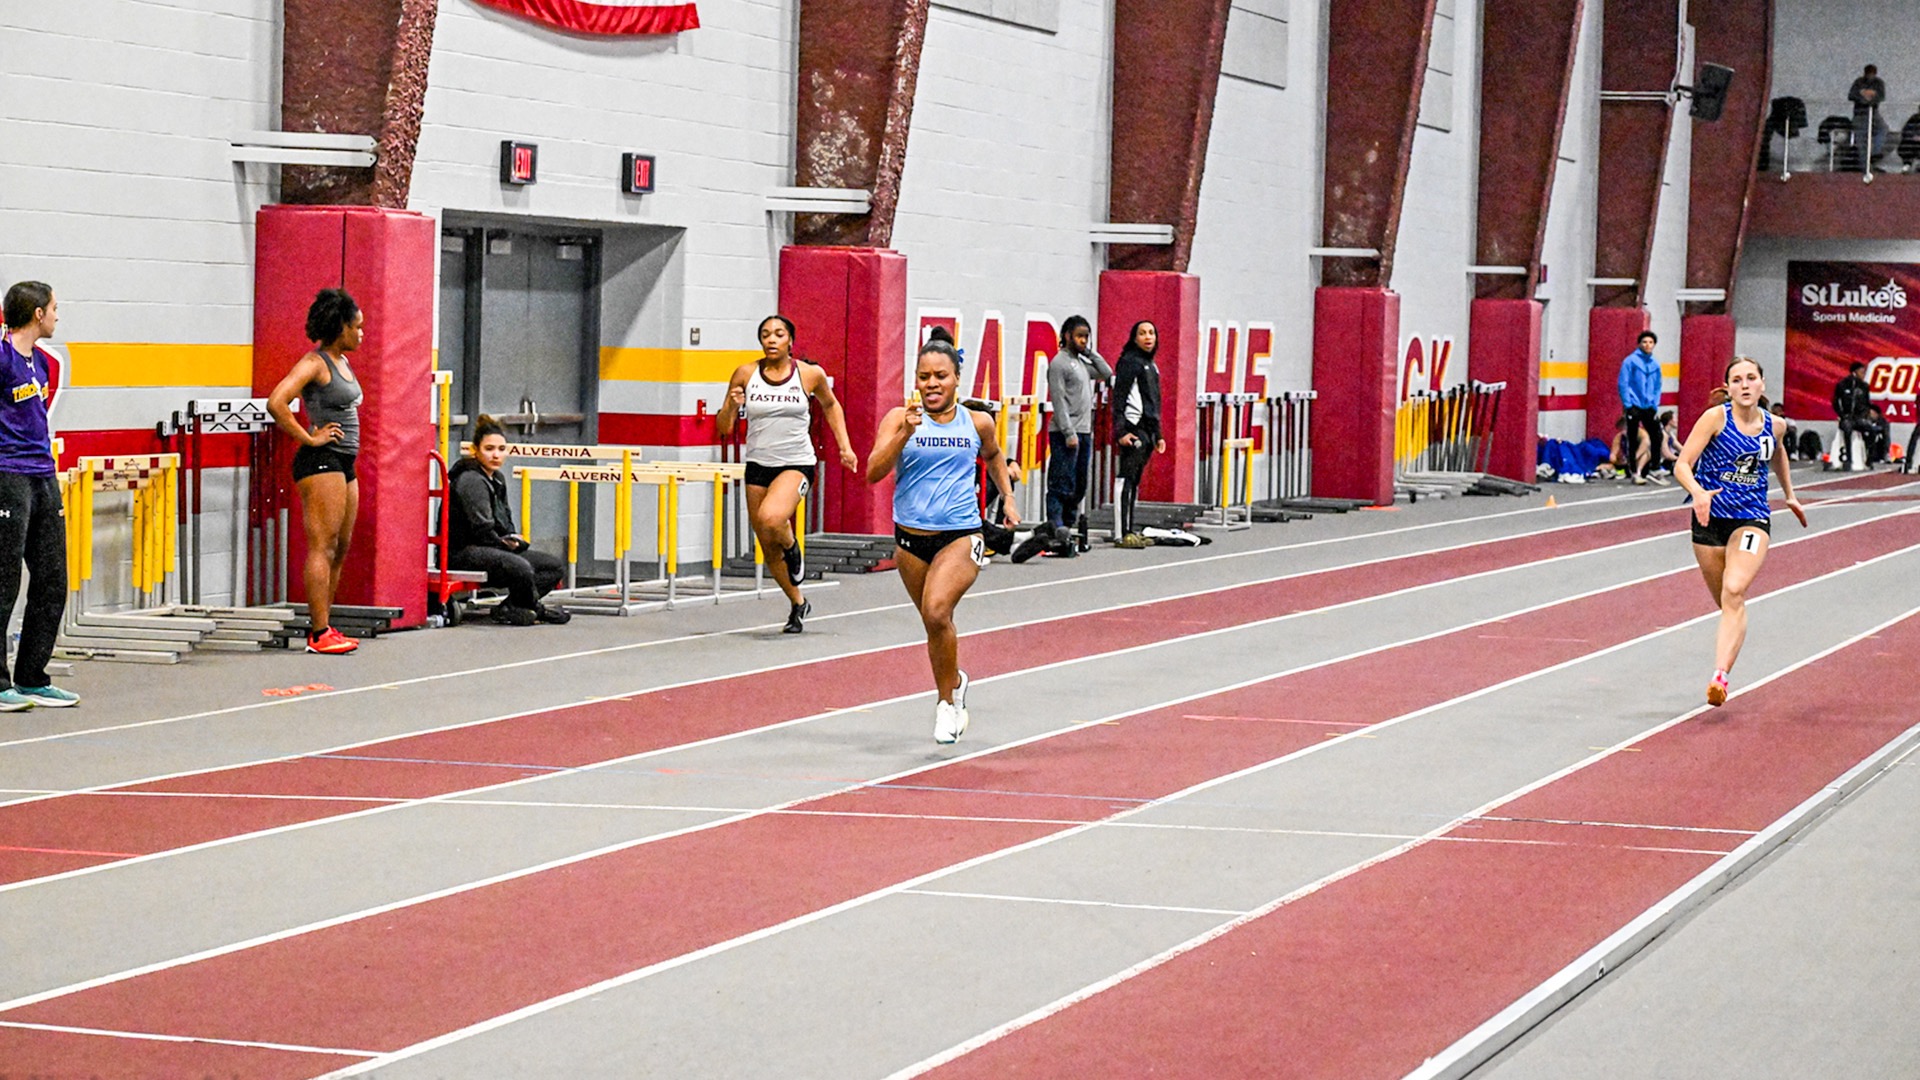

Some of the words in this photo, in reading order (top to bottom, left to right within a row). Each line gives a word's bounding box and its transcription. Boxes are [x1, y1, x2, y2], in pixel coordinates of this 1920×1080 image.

[1812, 311, 1846, 323] Sports
[1848, 312, 1896, 323] Medicine
[750, 393, 801, 403] EASTERN
[915, 437, 971, 448] WIDENER
[1761, 438, 1770, 459] 1
[509, 445, 591, 458] ALVERNIA
[559, 470, 638, 482] ALVERNA
[1745, 533, 1755, 550] 1
